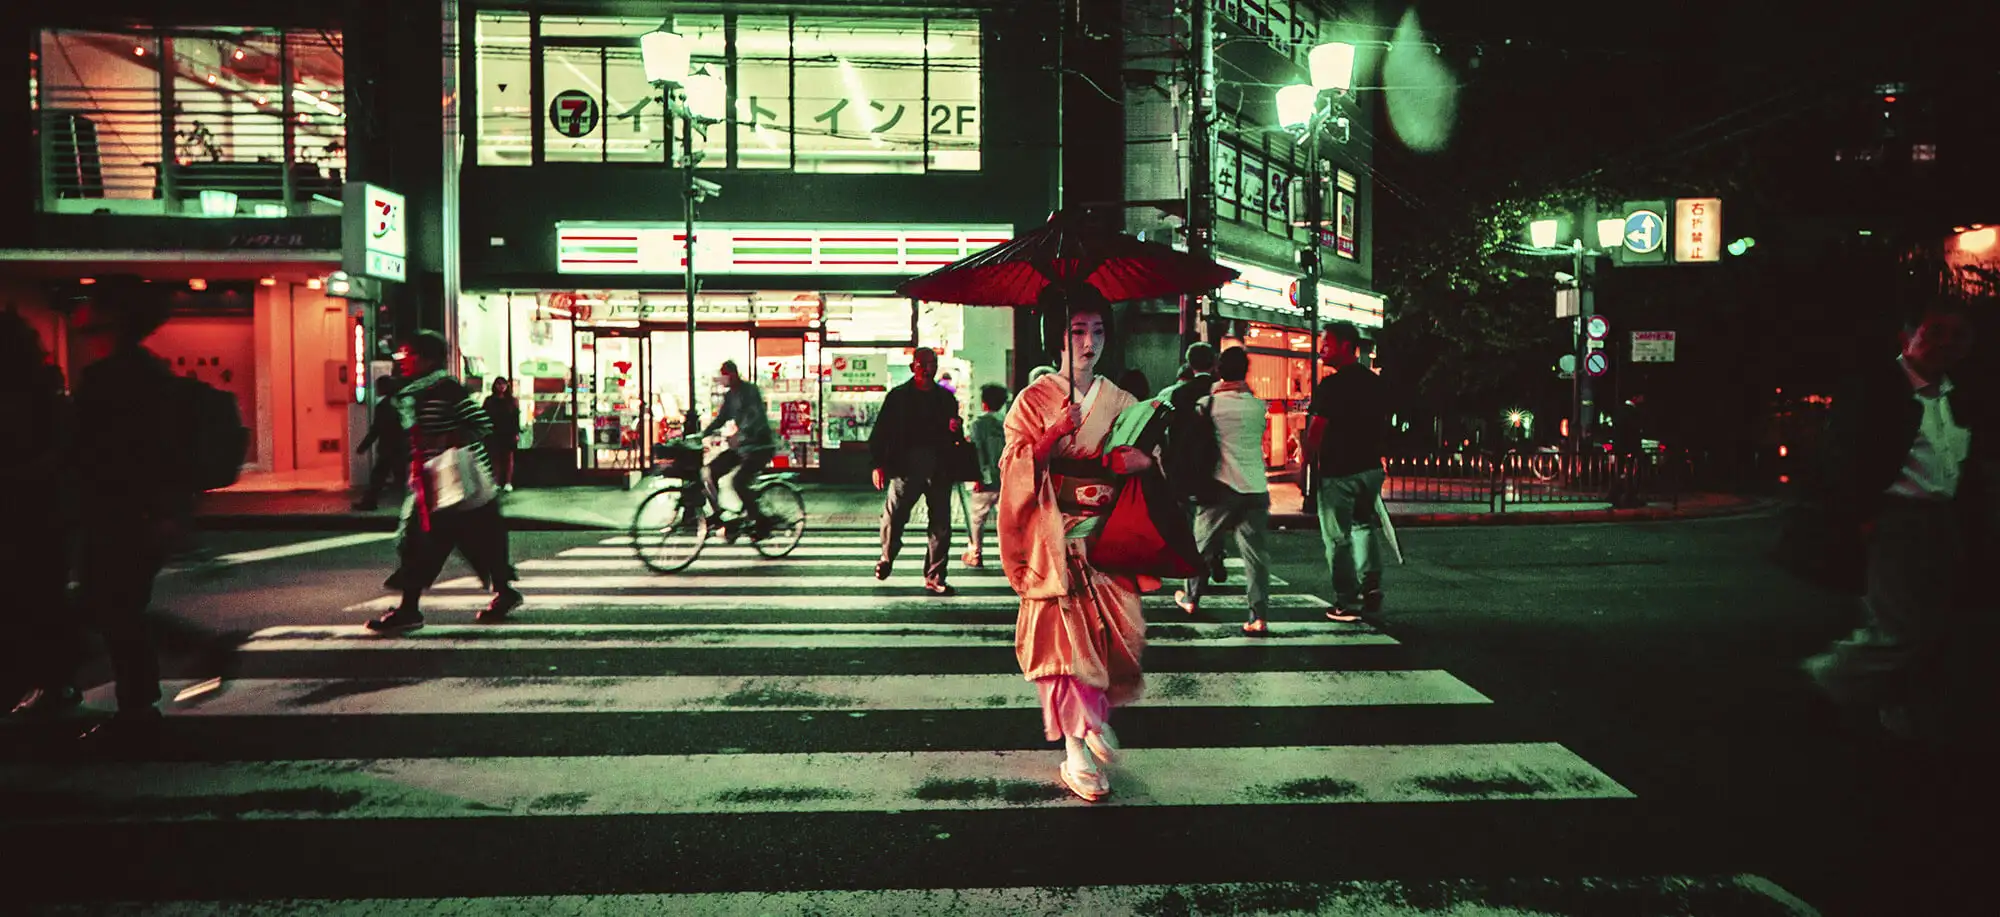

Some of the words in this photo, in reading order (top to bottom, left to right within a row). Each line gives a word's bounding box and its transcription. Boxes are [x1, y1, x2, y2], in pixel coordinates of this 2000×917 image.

[618, 95, 905, 135] イトイン
[930, 104, 977, 136] 2F
[1219, 167, 1233, 194] 牛
[1690, 202, 1705, 259] 右折禁止
